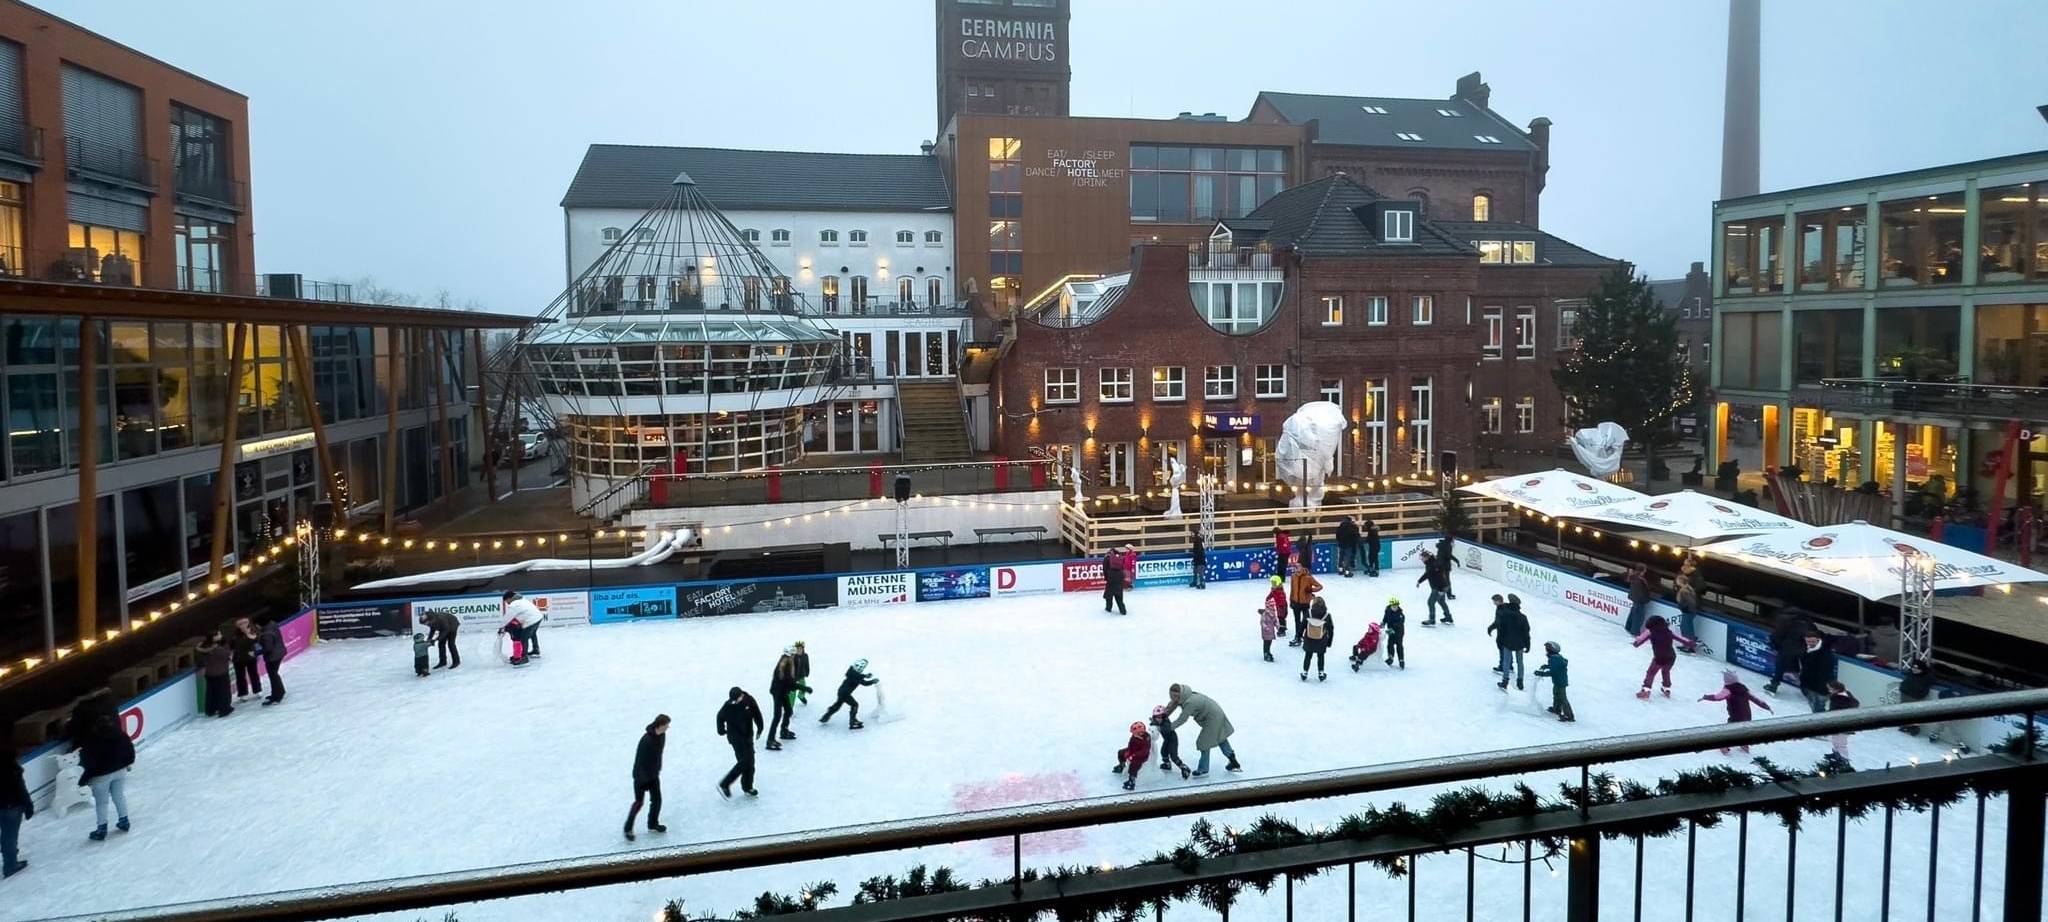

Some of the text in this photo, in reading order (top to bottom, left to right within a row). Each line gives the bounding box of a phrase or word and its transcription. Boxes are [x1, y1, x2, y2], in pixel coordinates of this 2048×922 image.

[961, 18, 1055, 40] GERMANIA
[961, 39, 1056, 61] CAMPUS
[1053, 159, 1097, 169] FACTORY
[1067, 168, 1099, 178] HOTEL
[1229, 416, 1252, 426] DABI
[1066, 564, 1105, 581] Höff
[1137, 560, 1194, 573] KERKHOF
[1223, 561, 1244, 569] DABI
[1506, 559, 1559, 584] GERMANIA
[847, 574, 906, 587] ANTENNE
[997, 568, 1016, 589] D
[1505, 571, 1559, 598] CAMPUS
[694, 586, 732, 607] FACTORY
[847, 584, 907, 596] MÜNSTER
[708, 594, 736, 609] HOTEL
[1565, 589, 1619, 616] DEILMANN
